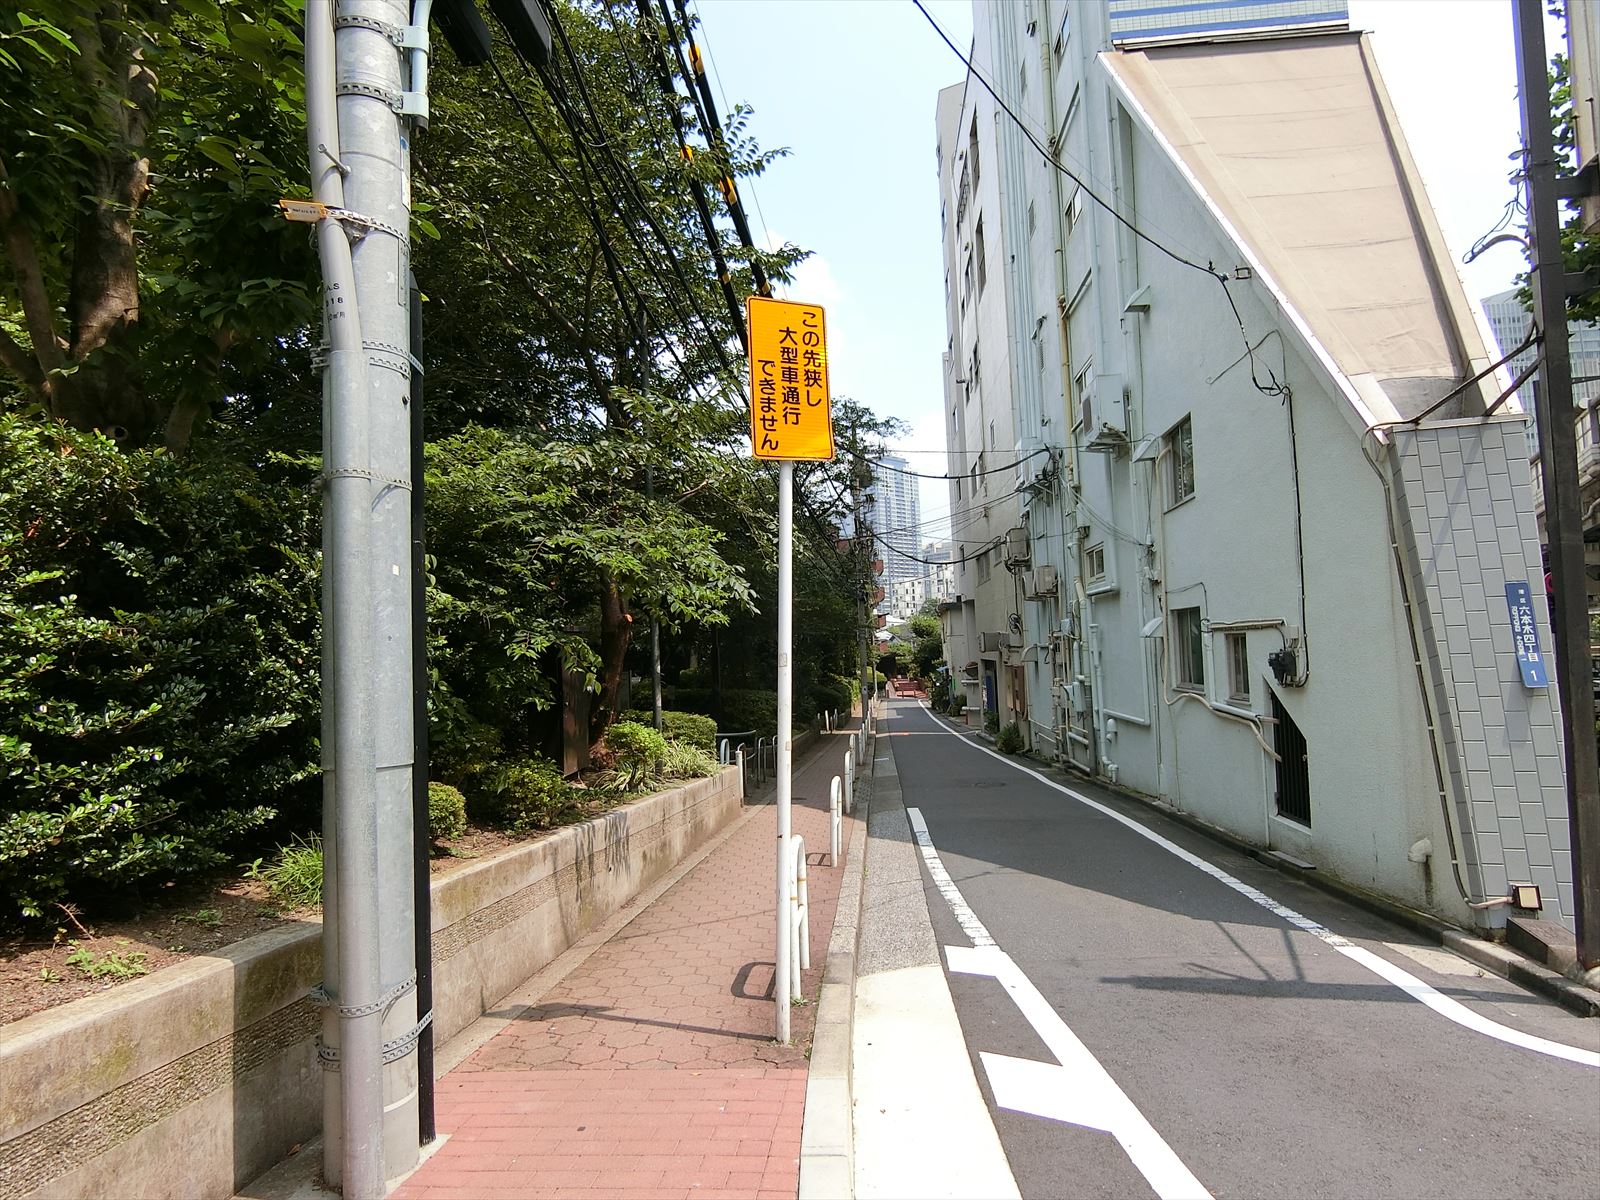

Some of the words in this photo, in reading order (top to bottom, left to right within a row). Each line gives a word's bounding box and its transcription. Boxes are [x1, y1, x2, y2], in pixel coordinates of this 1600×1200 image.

[757, 359, 779, 451] できません
[778, 326, 801, 426] 大型車通行
[802, 311, 823, 407] この先狭し
[1519, 606, 1539, 662] 六本木四丁目
[1530, 669, 1538, 682] 1
